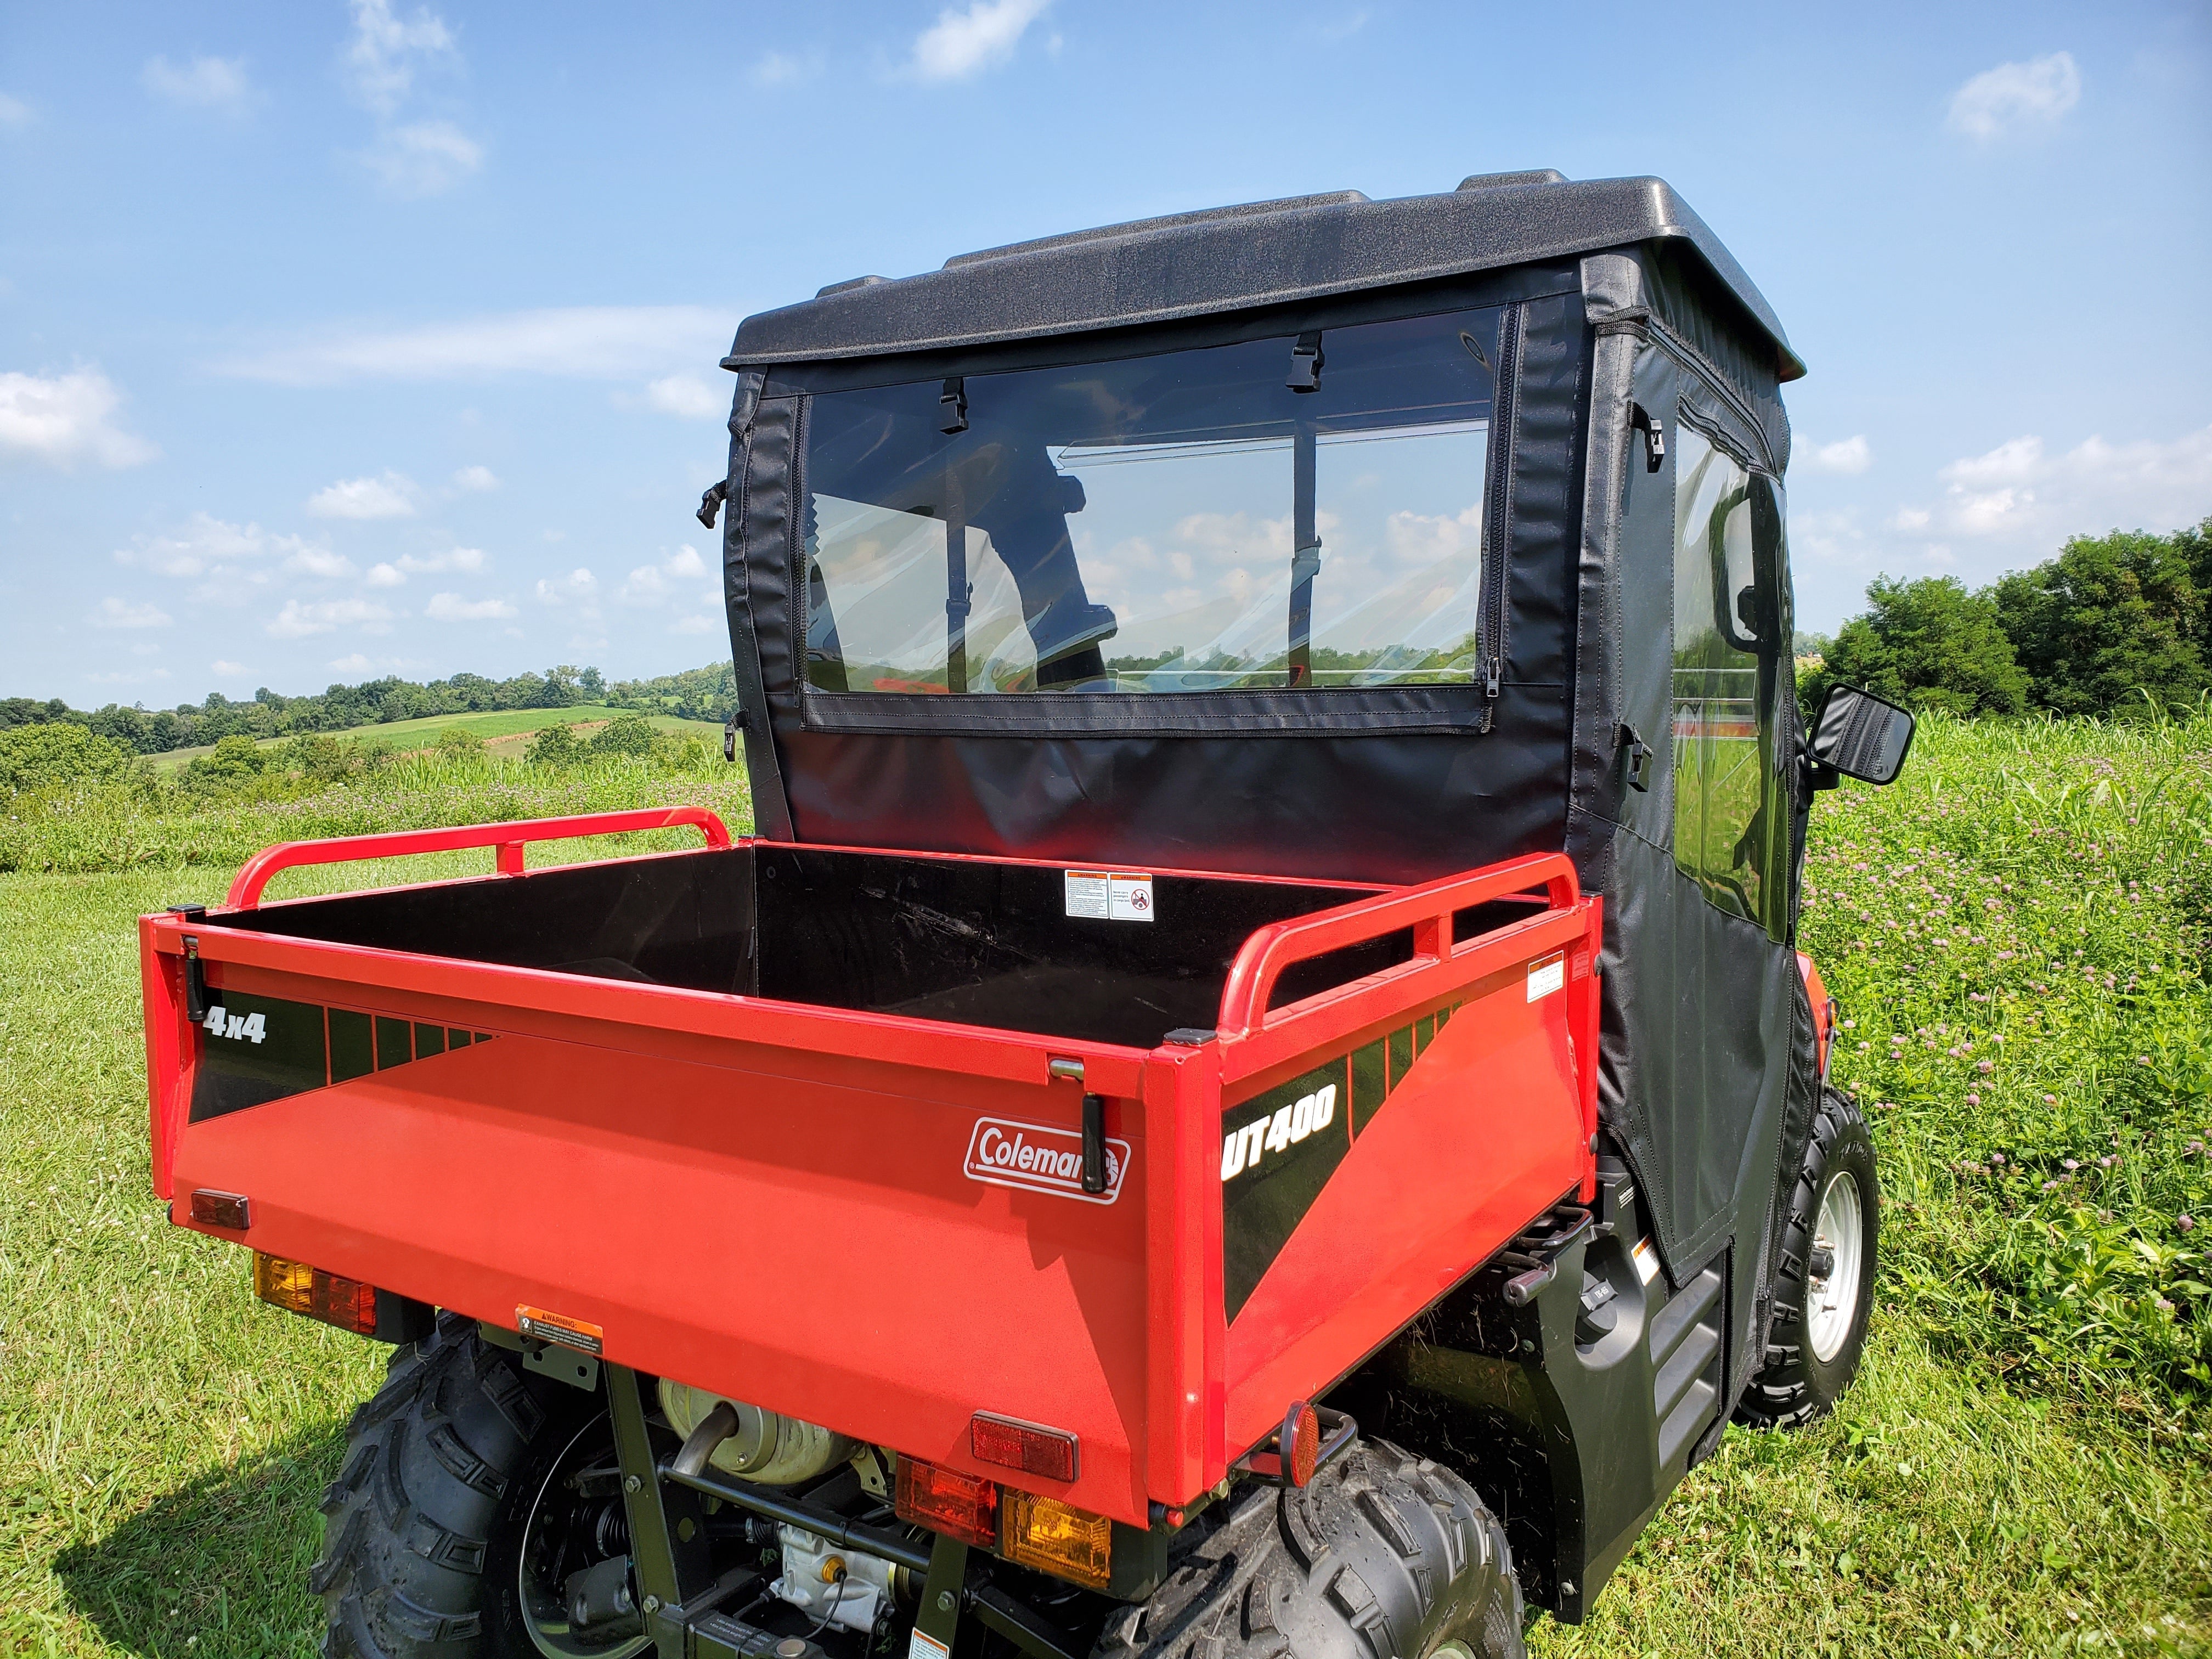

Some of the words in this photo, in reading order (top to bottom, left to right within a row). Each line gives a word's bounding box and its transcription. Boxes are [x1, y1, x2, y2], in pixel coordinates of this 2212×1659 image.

[1220, 1083, 1336, 1182] UT400
[534, 1321, 550, 1329] EXHAUST
[550, 1324, 562, 1333] FUMES
[570, 1330, 582, 1338] CAUSE
[546, 1313, 577, 1329] WARNING:
